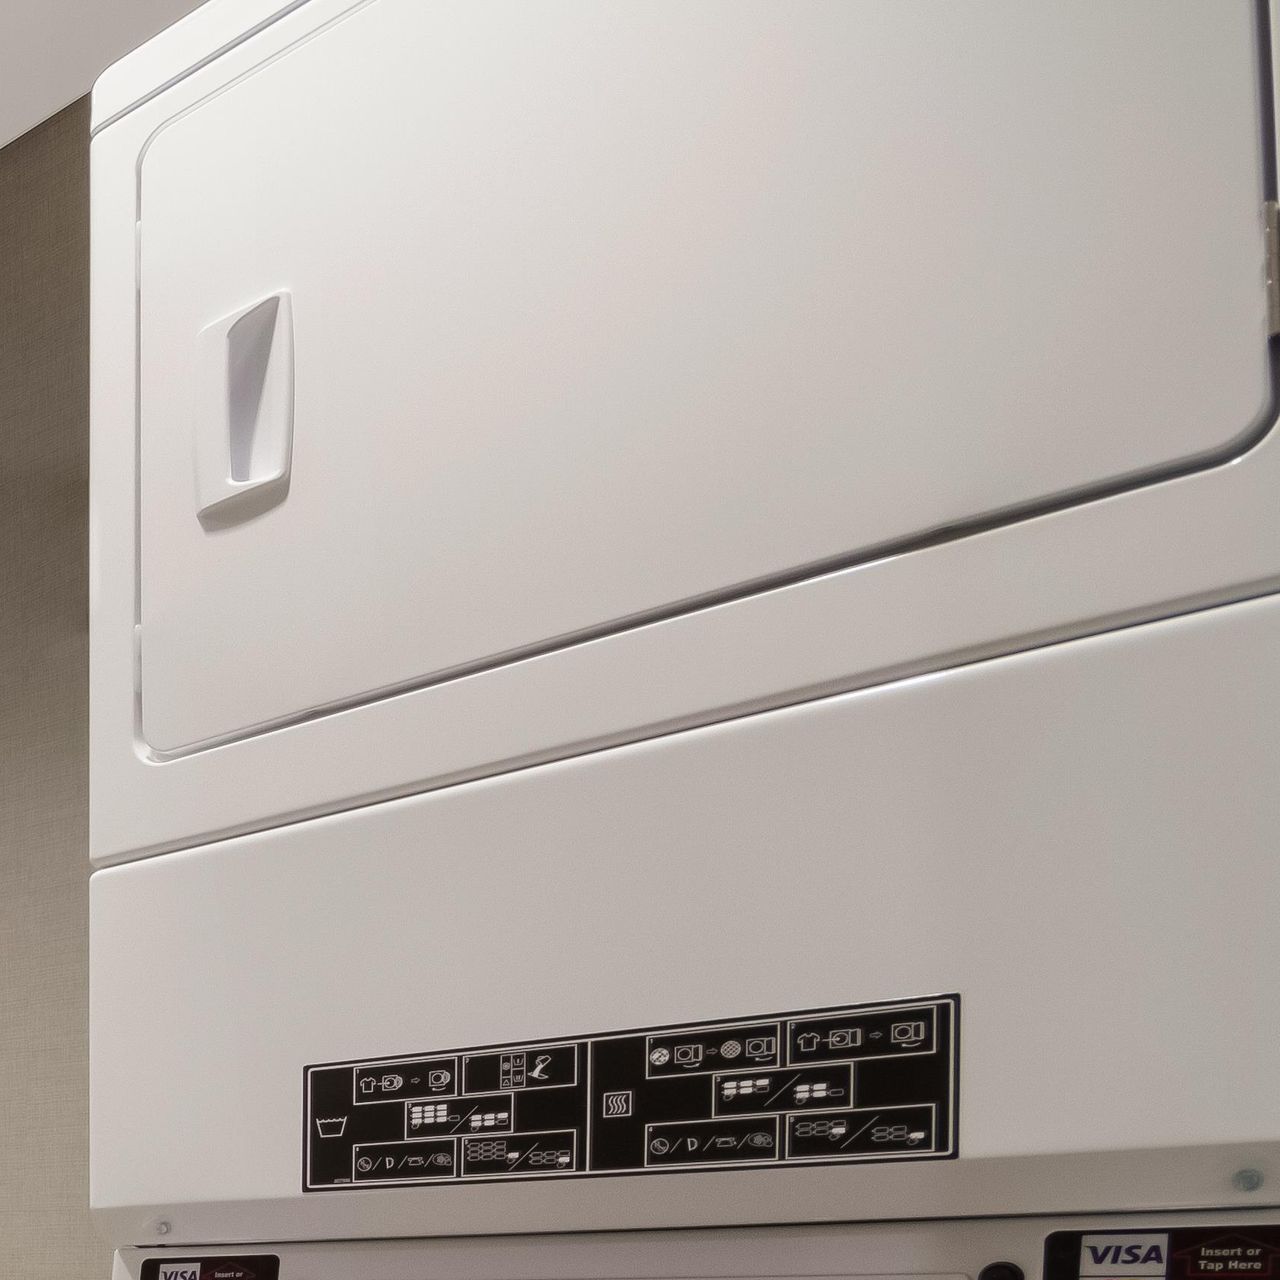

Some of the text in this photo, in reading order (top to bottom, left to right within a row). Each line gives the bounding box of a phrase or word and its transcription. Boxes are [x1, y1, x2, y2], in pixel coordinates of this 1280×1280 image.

[1085, 1245, 1163, 1264] VISA
[1201, 1248, 1261, 1256] Insert or
[1198, 1261, 1262, 1271] Tap Here
